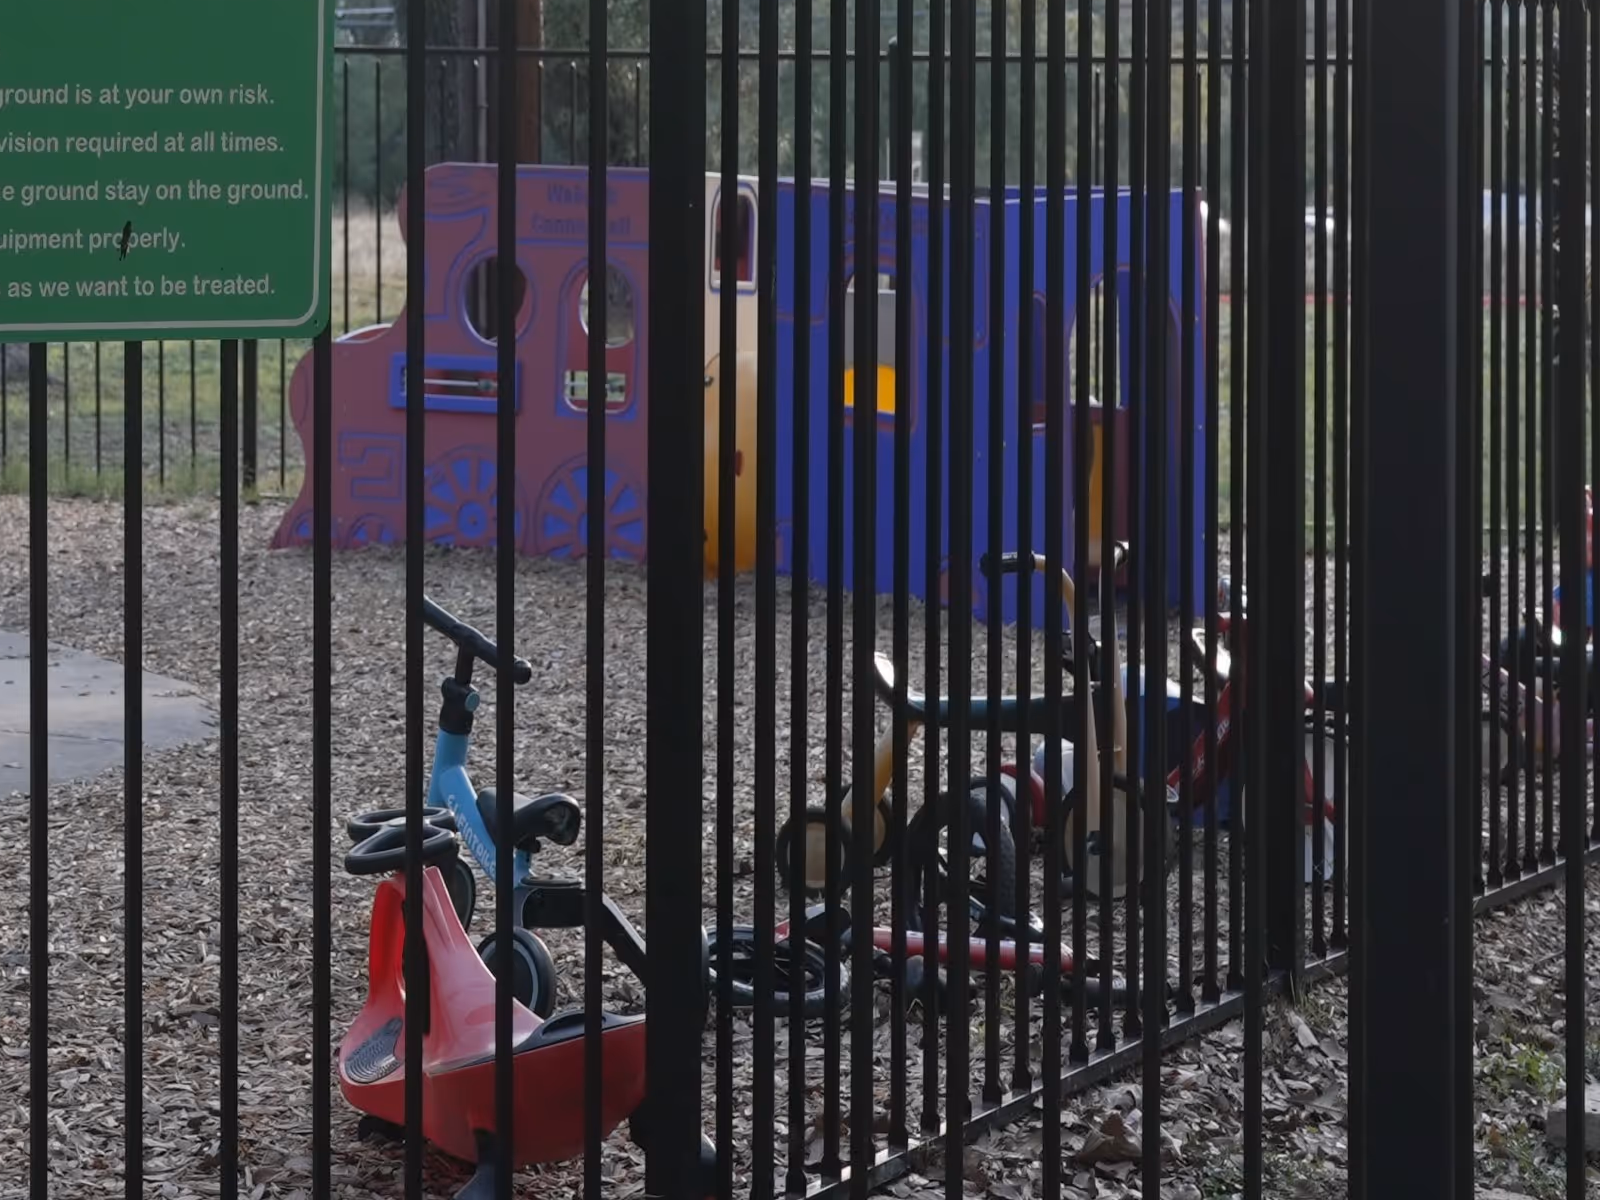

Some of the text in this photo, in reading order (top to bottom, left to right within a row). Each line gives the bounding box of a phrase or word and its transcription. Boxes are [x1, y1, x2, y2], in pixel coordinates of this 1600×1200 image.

[75, 83, 93, 105] is
[98, 83, 121, 105] at
[124, 88, 175, 110] your
[179, 88, 223, 105] own
[229, 83, 274, 105] risk.
[65, 131, 158, 158] required
[163, 131, 185, 153] at
[190, 130, 215, 152] all
[220, 131, 284, 153] times.
[20, 180, 99, 207] ground
[105, 180, 150, 206] stay
[155, 184, 182, 201] on
[187, 179, 222, 200] the
[227, 178, 309, 205] ground.
[7, 281, 33, 298] as
[38, 281, 70, 297] we
[75, 275, 129, 297] want
[133, 275, 155, 296] to
[160, 274, 187, 296] be
[192, 273, 275, 296] treated.
